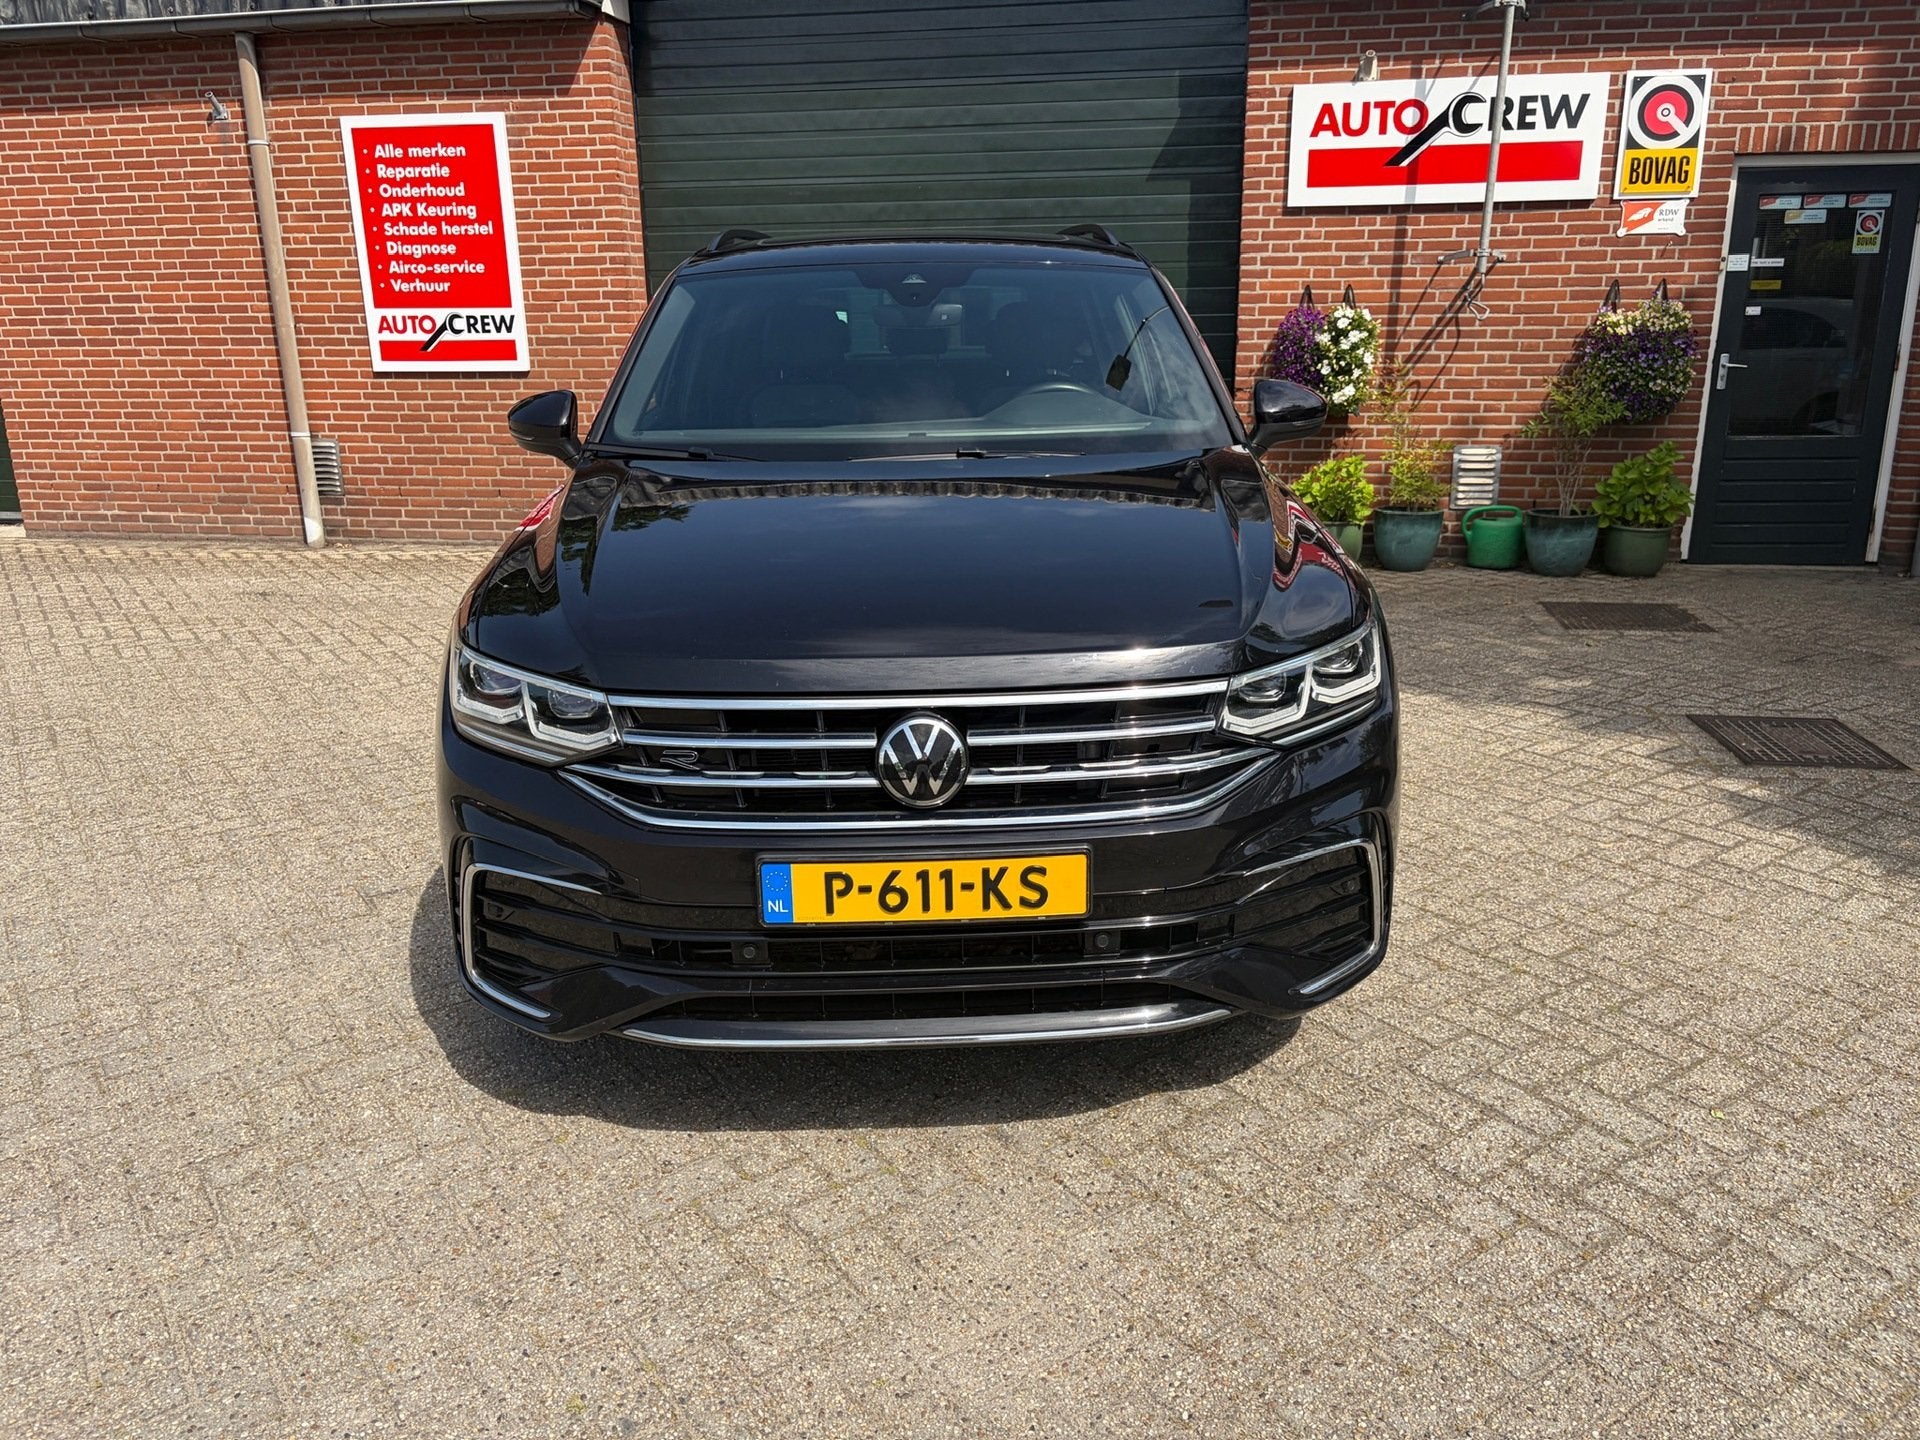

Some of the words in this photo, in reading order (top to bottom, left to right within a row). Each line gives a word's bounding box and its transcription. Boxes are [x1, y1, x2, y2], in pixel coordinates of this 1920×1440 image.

[1309, 98, 1429, 138] AUTO
[374, 144, 404, 158] Alle
[408, 142, 466, 157] merken
[377, 164, 450, 181] Reparatie
[1628, 155, 1691, 186] BOVAG
[379, 182, 465, 197] Onderhoud
[381, 202, 414, 217] APK
[416, 202, 477, 219] Keuring
[1658, 208, 1680, 217] RDW
[383, 221, 438, 236] Schade
[442, 220, 494, 235] herstel
[386, 241, 457, 258] Diagnose
[389, 260, 485, 274] Airco-service
[390, 278, 450, 293] Verhuur
[377, 314, 437, 335] AUTO
[447, 312, 515, 335] CREW
[823, 864, 1050, 916] P-611-KS
[767, 899, 789, 913] NL
